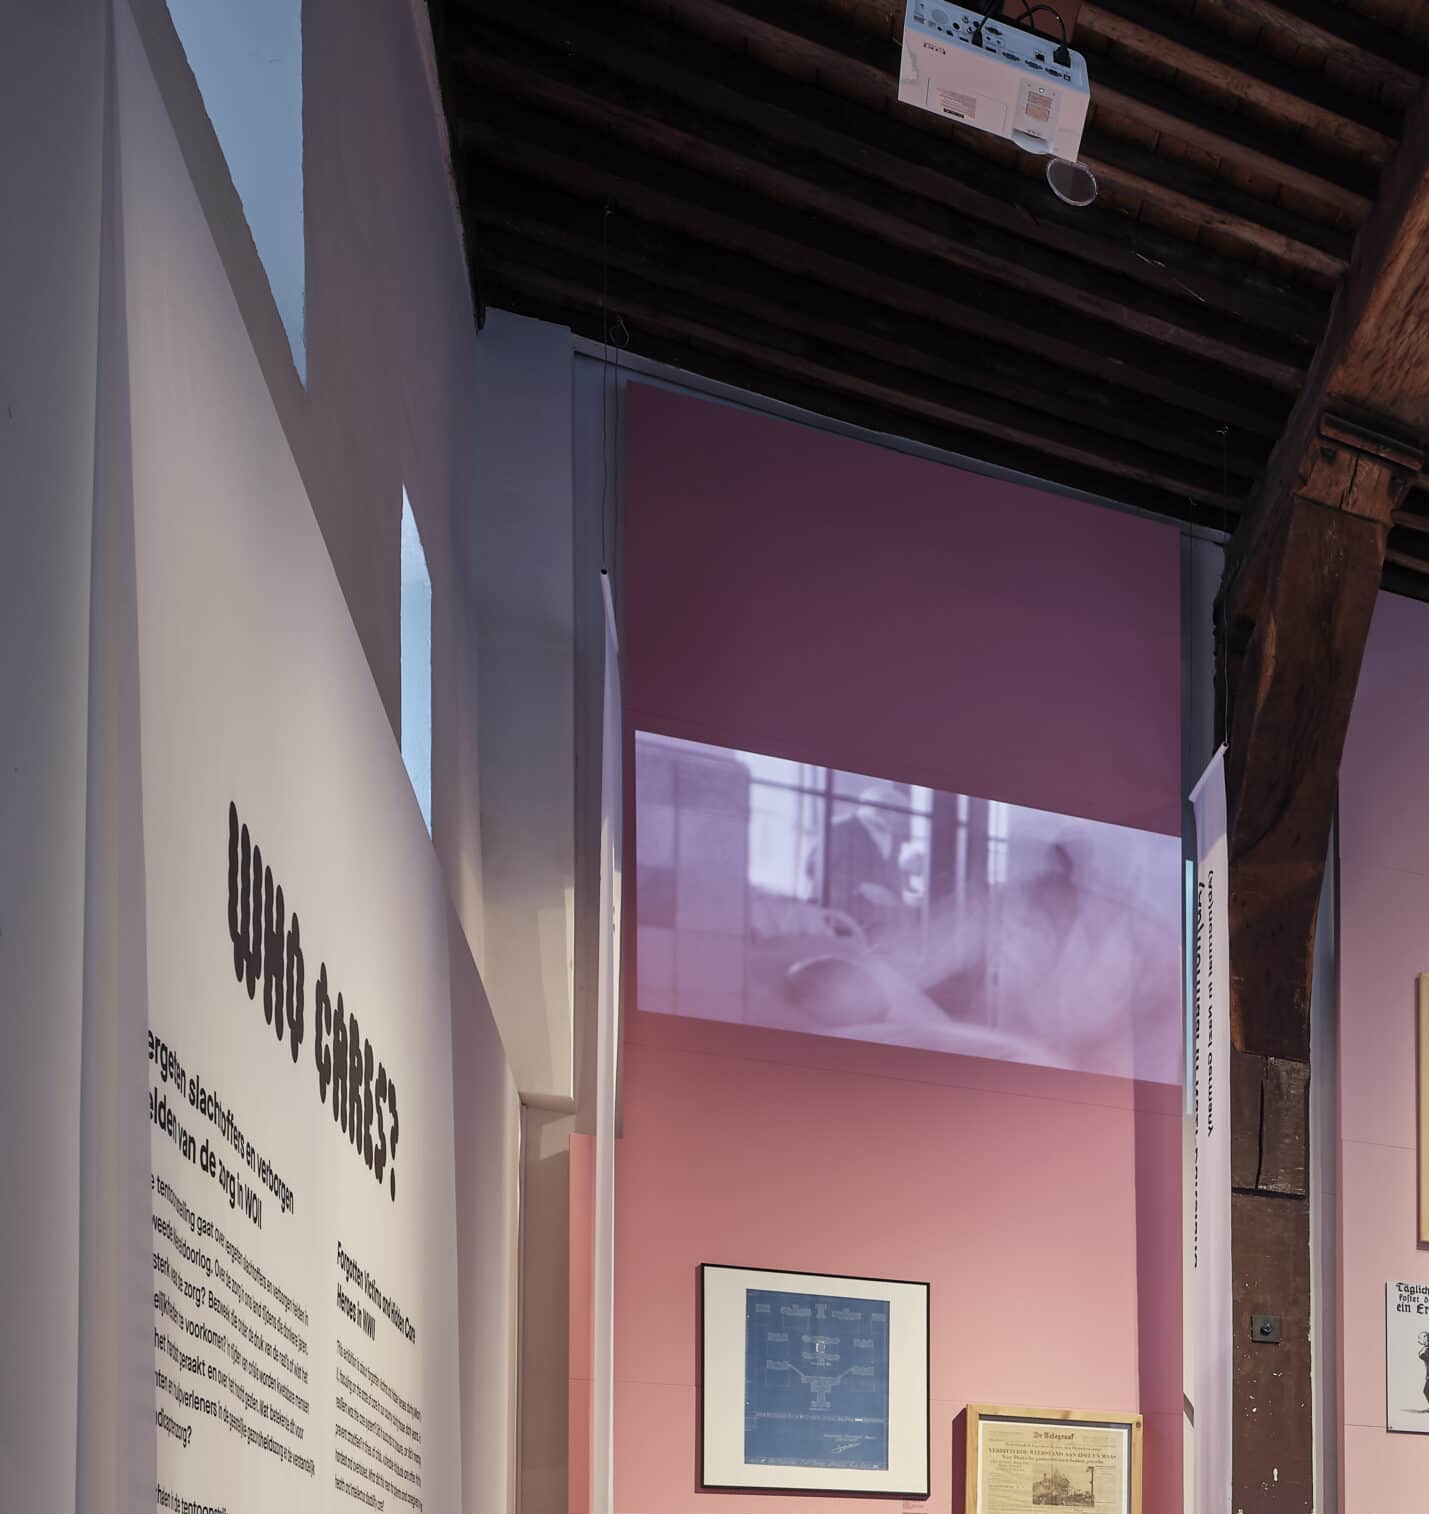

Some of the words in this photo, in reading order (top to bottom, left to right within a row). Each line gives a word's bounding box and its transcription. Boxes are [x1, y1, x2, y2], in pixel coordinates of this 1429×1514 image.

[228, 801, 304, 1062] WHO
[314, 962, 399, 1202] CARES?
[177, 1122, 197, 1163] van
[200, 1139, 217, 1178] de
[237, 1172, 244, 1211] in
[246, 1141, 257, 1173] en
[256, 1153, 295, 1214] verborgen
[196, 1216, 214, 1236] gaat
[184, 1281, 206, 1308] zorg?
[337, 1241, 364, 1290] Forgotten
[404, 1316, 416, 1344] Care
[337, 1282, 356, 1322] Heroes
[1397, 1303, 1411, 1313] ein
[207, 1365, 218, 1381] en
